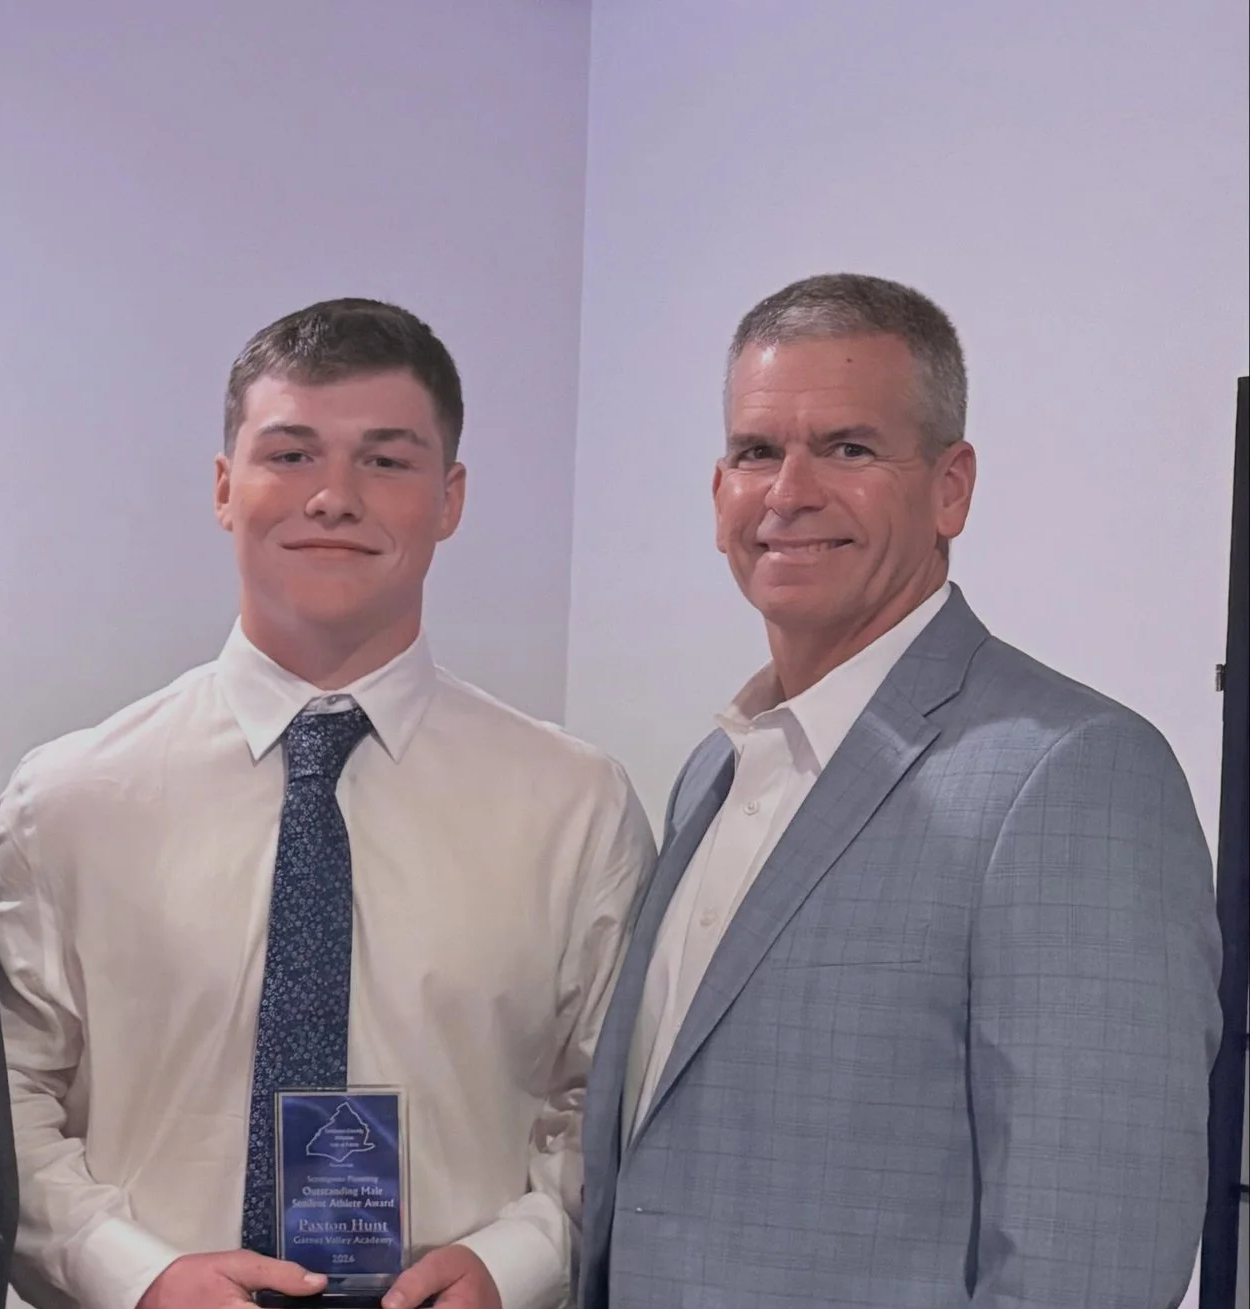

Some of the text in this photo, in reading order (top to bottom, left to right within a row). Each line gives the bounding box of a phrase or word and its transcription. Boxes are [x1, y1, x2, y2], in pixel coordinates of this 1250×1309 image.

[301, 1186, 383, 1197] Outstanding Male
[329, 1198, 361, 1208] Athlete
[364, 1198, 395, 1208] Award
[298, 1218, 389, 1233] Paxton Hunt
[325, 1236, 350, 1246] Valley
[353, 1236, 394, 1246] Academy
